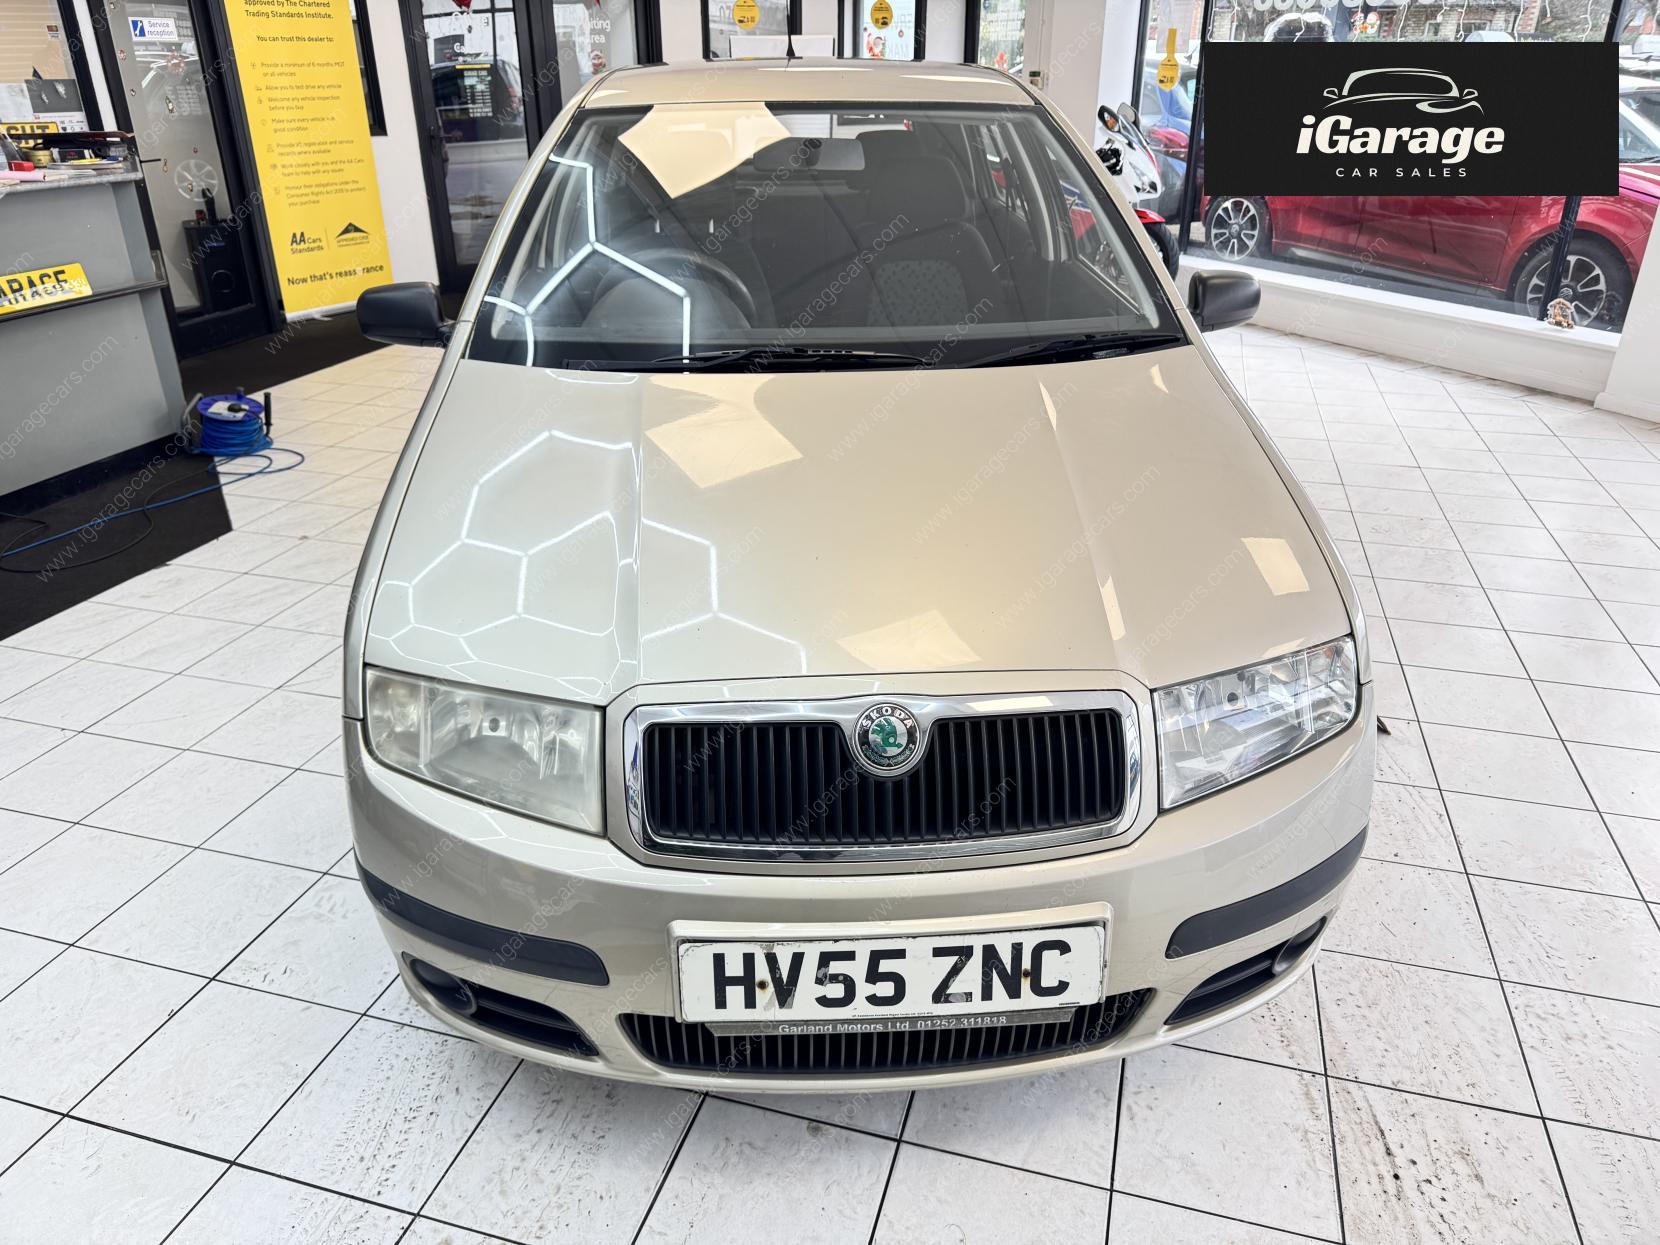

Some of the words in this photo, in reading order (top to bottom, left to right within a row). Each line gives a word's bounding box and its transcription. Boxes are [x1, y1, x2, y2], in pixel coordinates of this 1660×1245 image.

[290, 232, 306, 246] AA
[291, 245, 324, 254] Standards
[288, 277, 308, 286] Now
[309, 272, 334, 282] that's
[335, 264, 384, 278] reassrance
[713, 948, 906, 1009] HV55
[932, 940, 1072, 1004] ZNC
[779, 1024, 832, 1033] Garland
[837, 1022, 883, 1032] Motors
[888, 1021, 909, 1031] Ltd
[917, 1018, 955, 1029] 01252
[960, 1016, 1007, 1027] 311818
